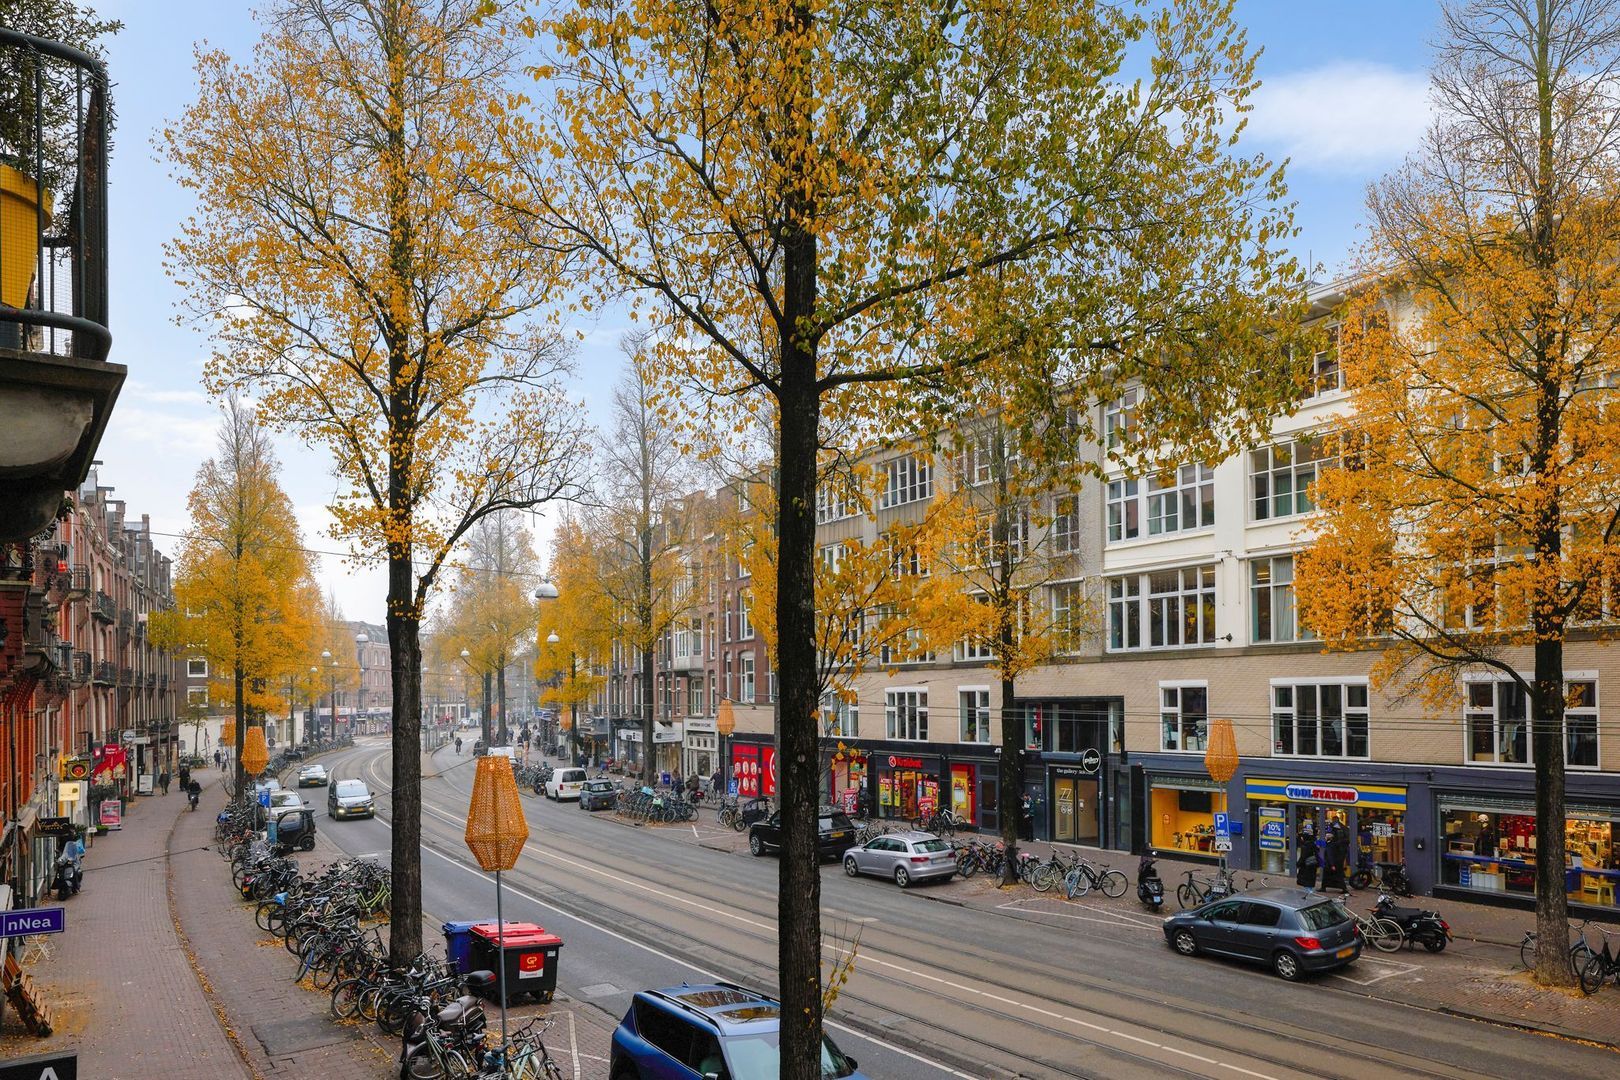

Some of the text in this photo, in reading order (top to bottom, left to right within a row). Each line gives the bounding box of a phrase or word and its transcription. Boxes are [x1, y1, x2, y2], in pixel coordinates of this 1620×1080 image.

[1287, 787, 1356, 801] TOOLSTATION
[1216, 814, 1225, 827] P
[1267, 823, 1281, 832] 10%
[8, 917, 52, 931] nNea
